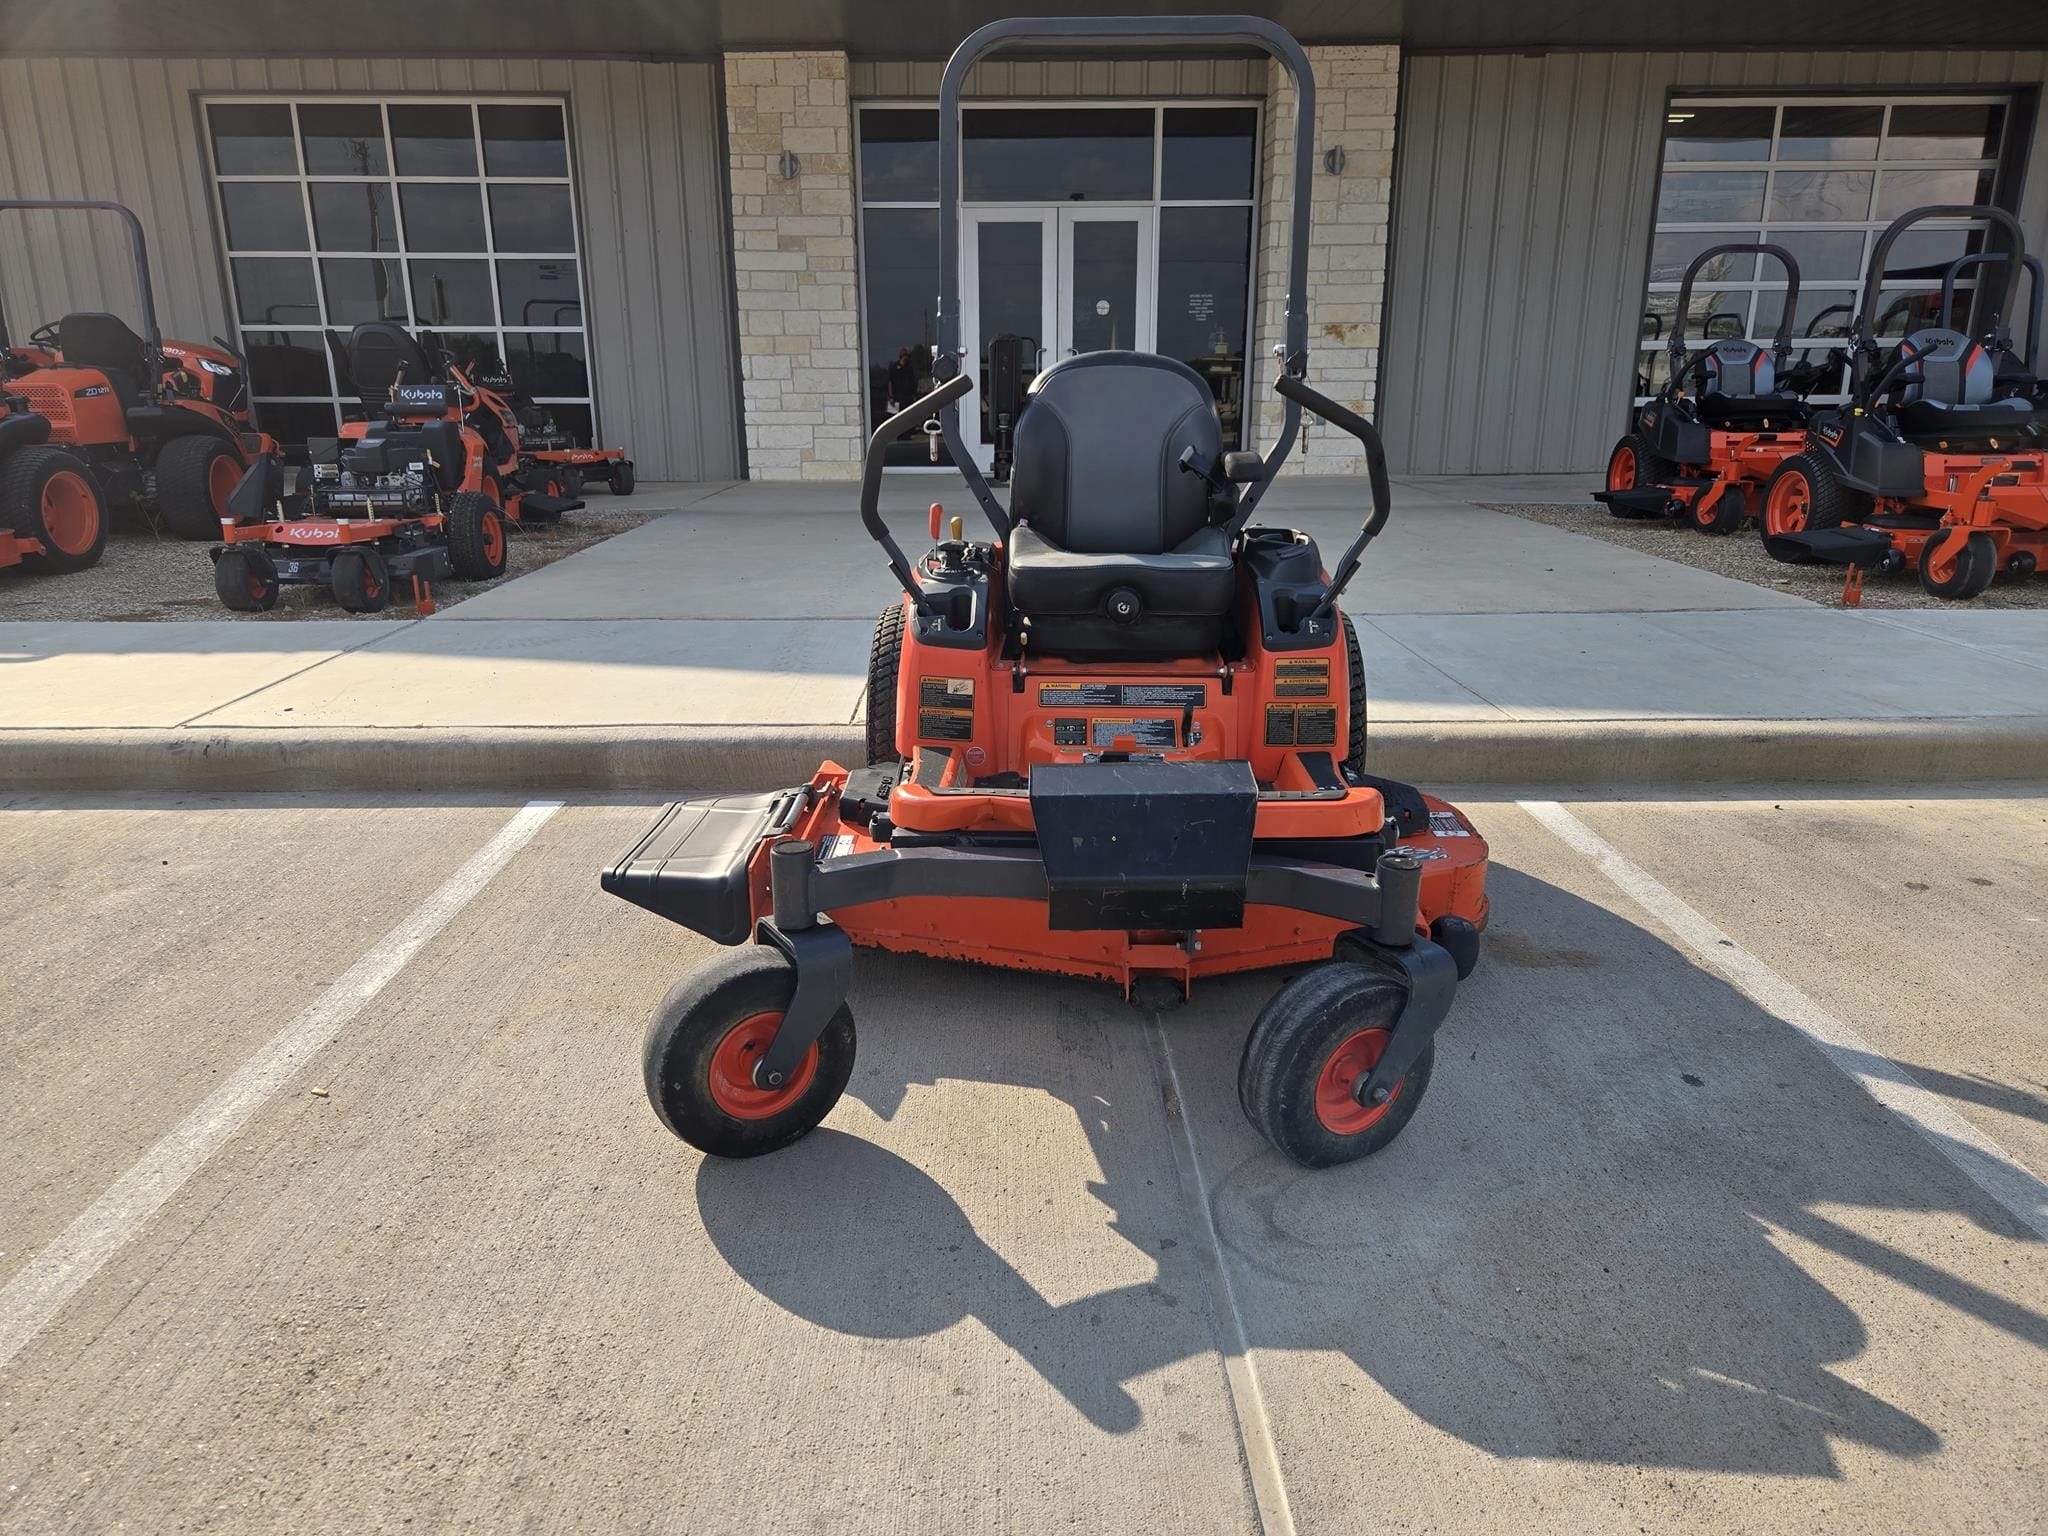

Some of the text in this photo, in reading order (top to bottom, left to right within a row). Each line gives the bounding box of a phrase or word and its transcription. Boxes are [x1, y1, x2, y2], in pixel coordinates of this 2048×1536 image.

[400, 388, 443, 400] Kubota
[289, 528, 340, 538] Kubot
[288, 562, 299, 573] 36
